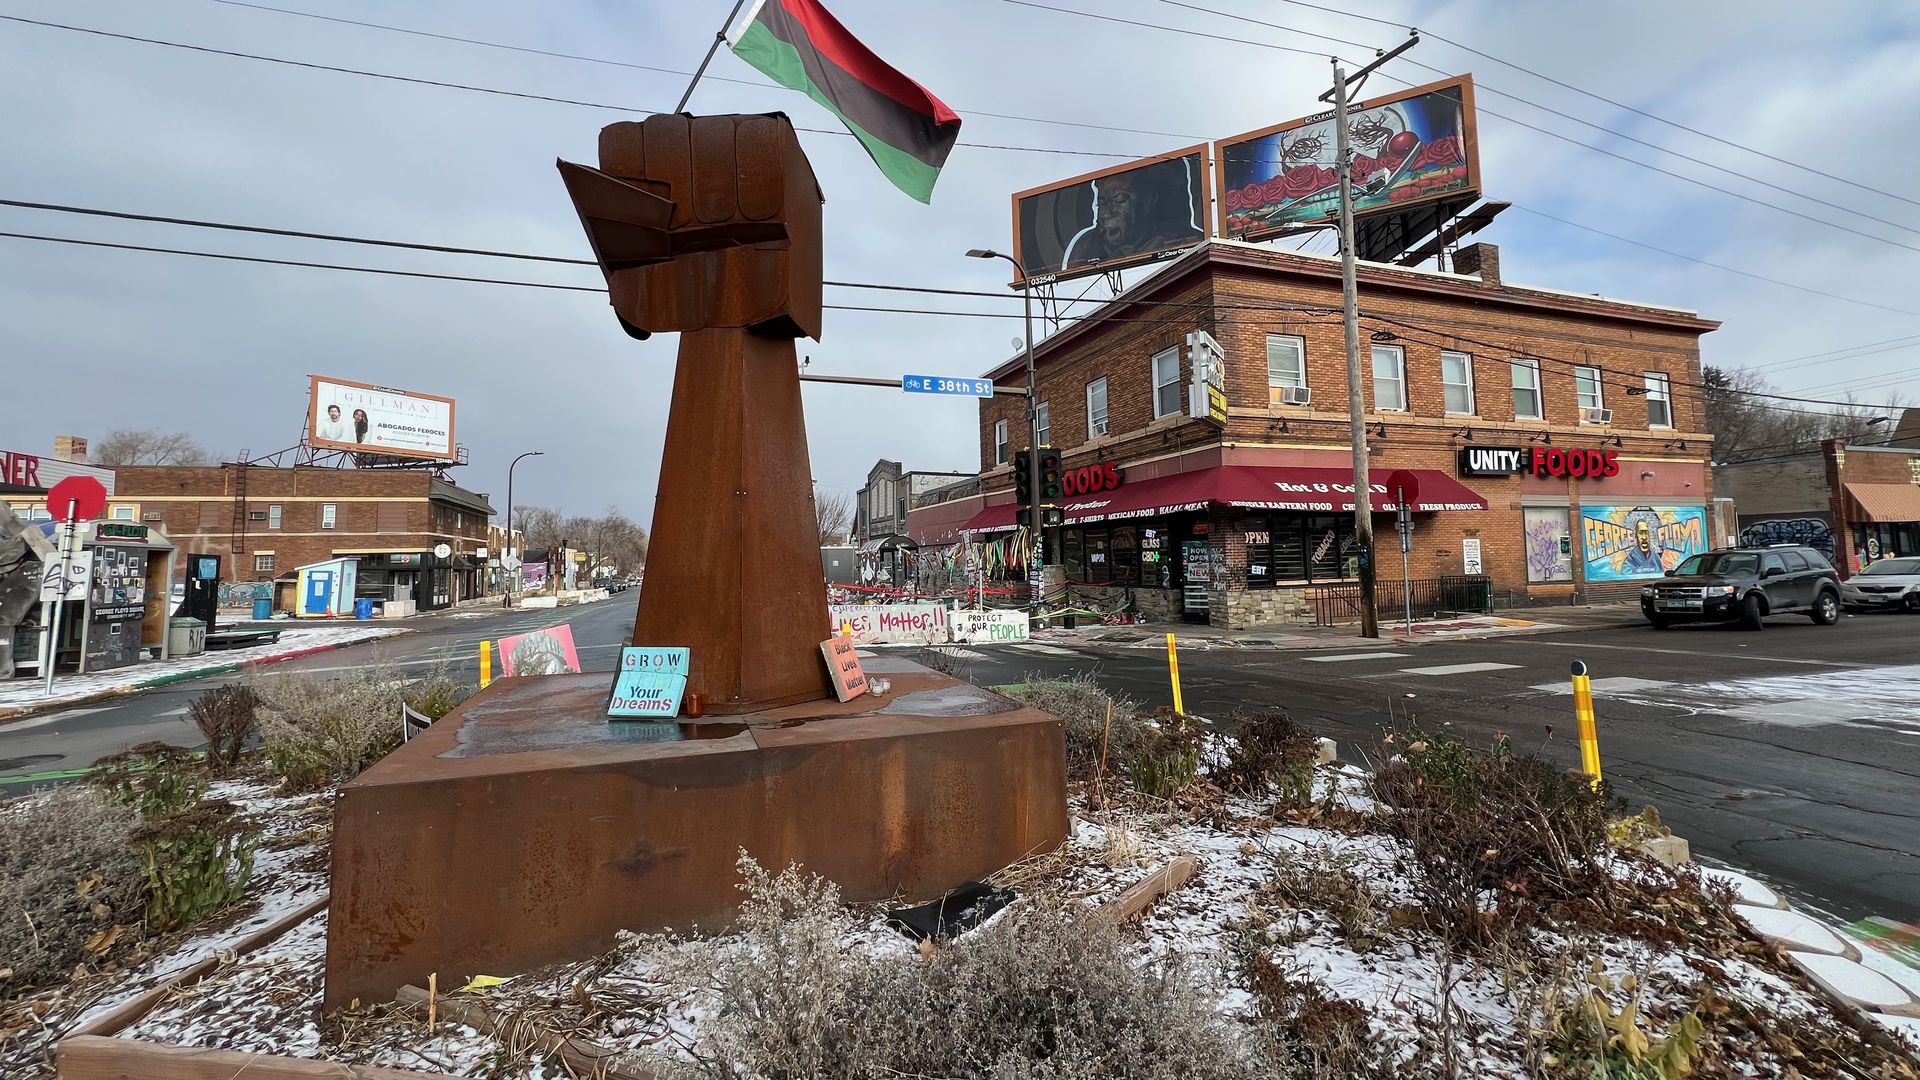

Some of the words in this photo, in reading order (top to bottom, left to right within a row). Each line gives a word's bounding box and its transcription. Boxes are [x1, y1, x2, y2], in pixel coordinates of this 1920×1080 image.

[1030, 274, 1056, 286] 032540
[923, 379, 932, 390] E
[938, 382, 970, 393] 38th
[975, 382, 990, 394] St
[344, 392, 432, 414] GILLMAN
[377, 422, 417, 433] ABOGADOS
[417, 427, 446, 437] FEROCES
[1469, 449, 1520, 471] UNITY
[1532, 447, 1620, 478] FOODS
[1063, 459, 1120, 497] OODS
[1274, 482, 1313, 493] Hot
[1229, 500, 1268, 508] MIDDLE
[1267, 501, 1308, 510] EASTERN
[1309, 502, 1333, 511] FOOD
[1418, 503, 1444, 511] FRESH
[1064, 517, 1077, 526] MILK
[1080, 514, 1105, 524] T-SHIRTS
[1108, 510, 1136, 520] MEXICAN
[1136, 508, 1155, 518] FOOD
[1159, 504, 1182, 515] HALAL
[1183, 501, 1209, 512] MEAT
[1145, 529, 1157, 538] EBT
[1583, 515, 1637, 563] GEORGE
[1141, 538, 1160, 548] GLASS
[1311, 529, 1336, 565] TOBACCO
[1189, 569, 1209, 577] NEW
[1251, 564, 1267, 576] EBT
[95, 608, 114, 616] GEORGE
[967, 614, 1003, 622] PROTECT
[879, 606, 945, 633] Matter!!
[971, 622, 988, 631] OUR
[989, 623, 1027, 641] PEOPLE
[189, 628, 206, 652] RIP
[834, 642, 852, 655] Black
[625, 653, 682, 667] GROW
[841, 660, 858, 672] Lives
[846, 676, 866, 690] Matter
[630, 686, 663, 699] Your
